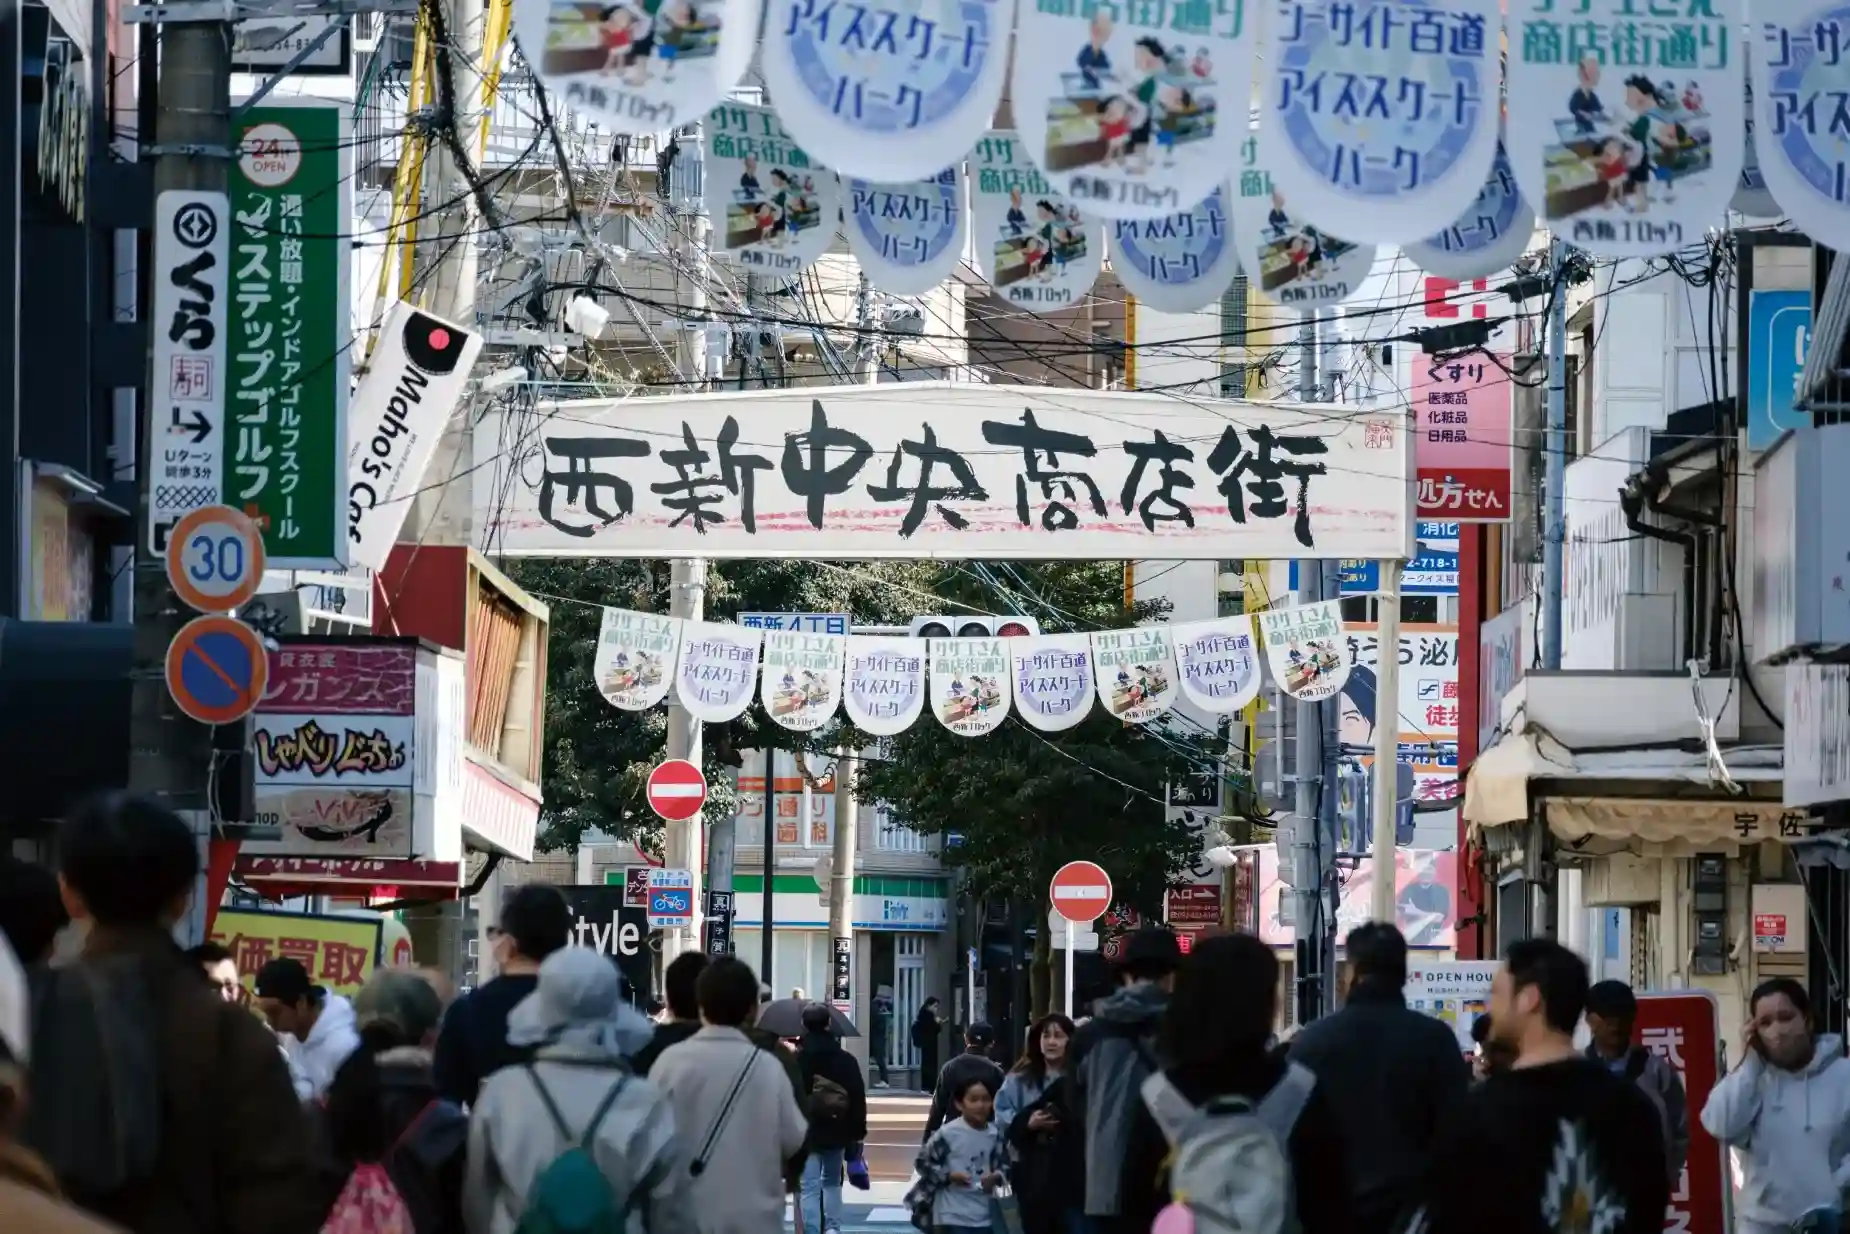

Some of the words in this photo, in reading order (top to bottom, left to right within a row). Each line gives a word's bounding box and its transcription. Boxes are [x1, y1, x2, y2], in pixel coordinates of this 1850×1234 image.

[1522, 19, 1728, 69] 商店街通り
[833, 75, 922, 128] パーク
[1277, 68, 1482, 124] アイススケート
[253, 161, 286, 173] OPEN
[1331, 144, 1419, 190] パーク
[882, 233, 928, 263] パーク
[1151, 252, 1200, 281] パーク
[168, 250, 216, 351] くら
[235, 244, 276, 500] ステップゴルフ
[1427, 363, 1484, 383] くすり
[1428, 392, 1468, 405] 医薬品
[361, 364, 429, 479] Maho's
[1428, 410, 1468, 424] 化粧品
[1428, 429, 1468, 443] 日用品
[165, 449, 212, 463] Uターン
[165, 465, 212, 480] 徒歩3分
[538, 399, 1329, 549] 西新中央商店街
[1422, 522, 1459, 536] 消化
[190, 535, 243, 582] 30
[1170, 889, 1193, 900] 入口
[210, 932, 369, 987] 価買取
[1426, 972, 1462, 982] OPEN
